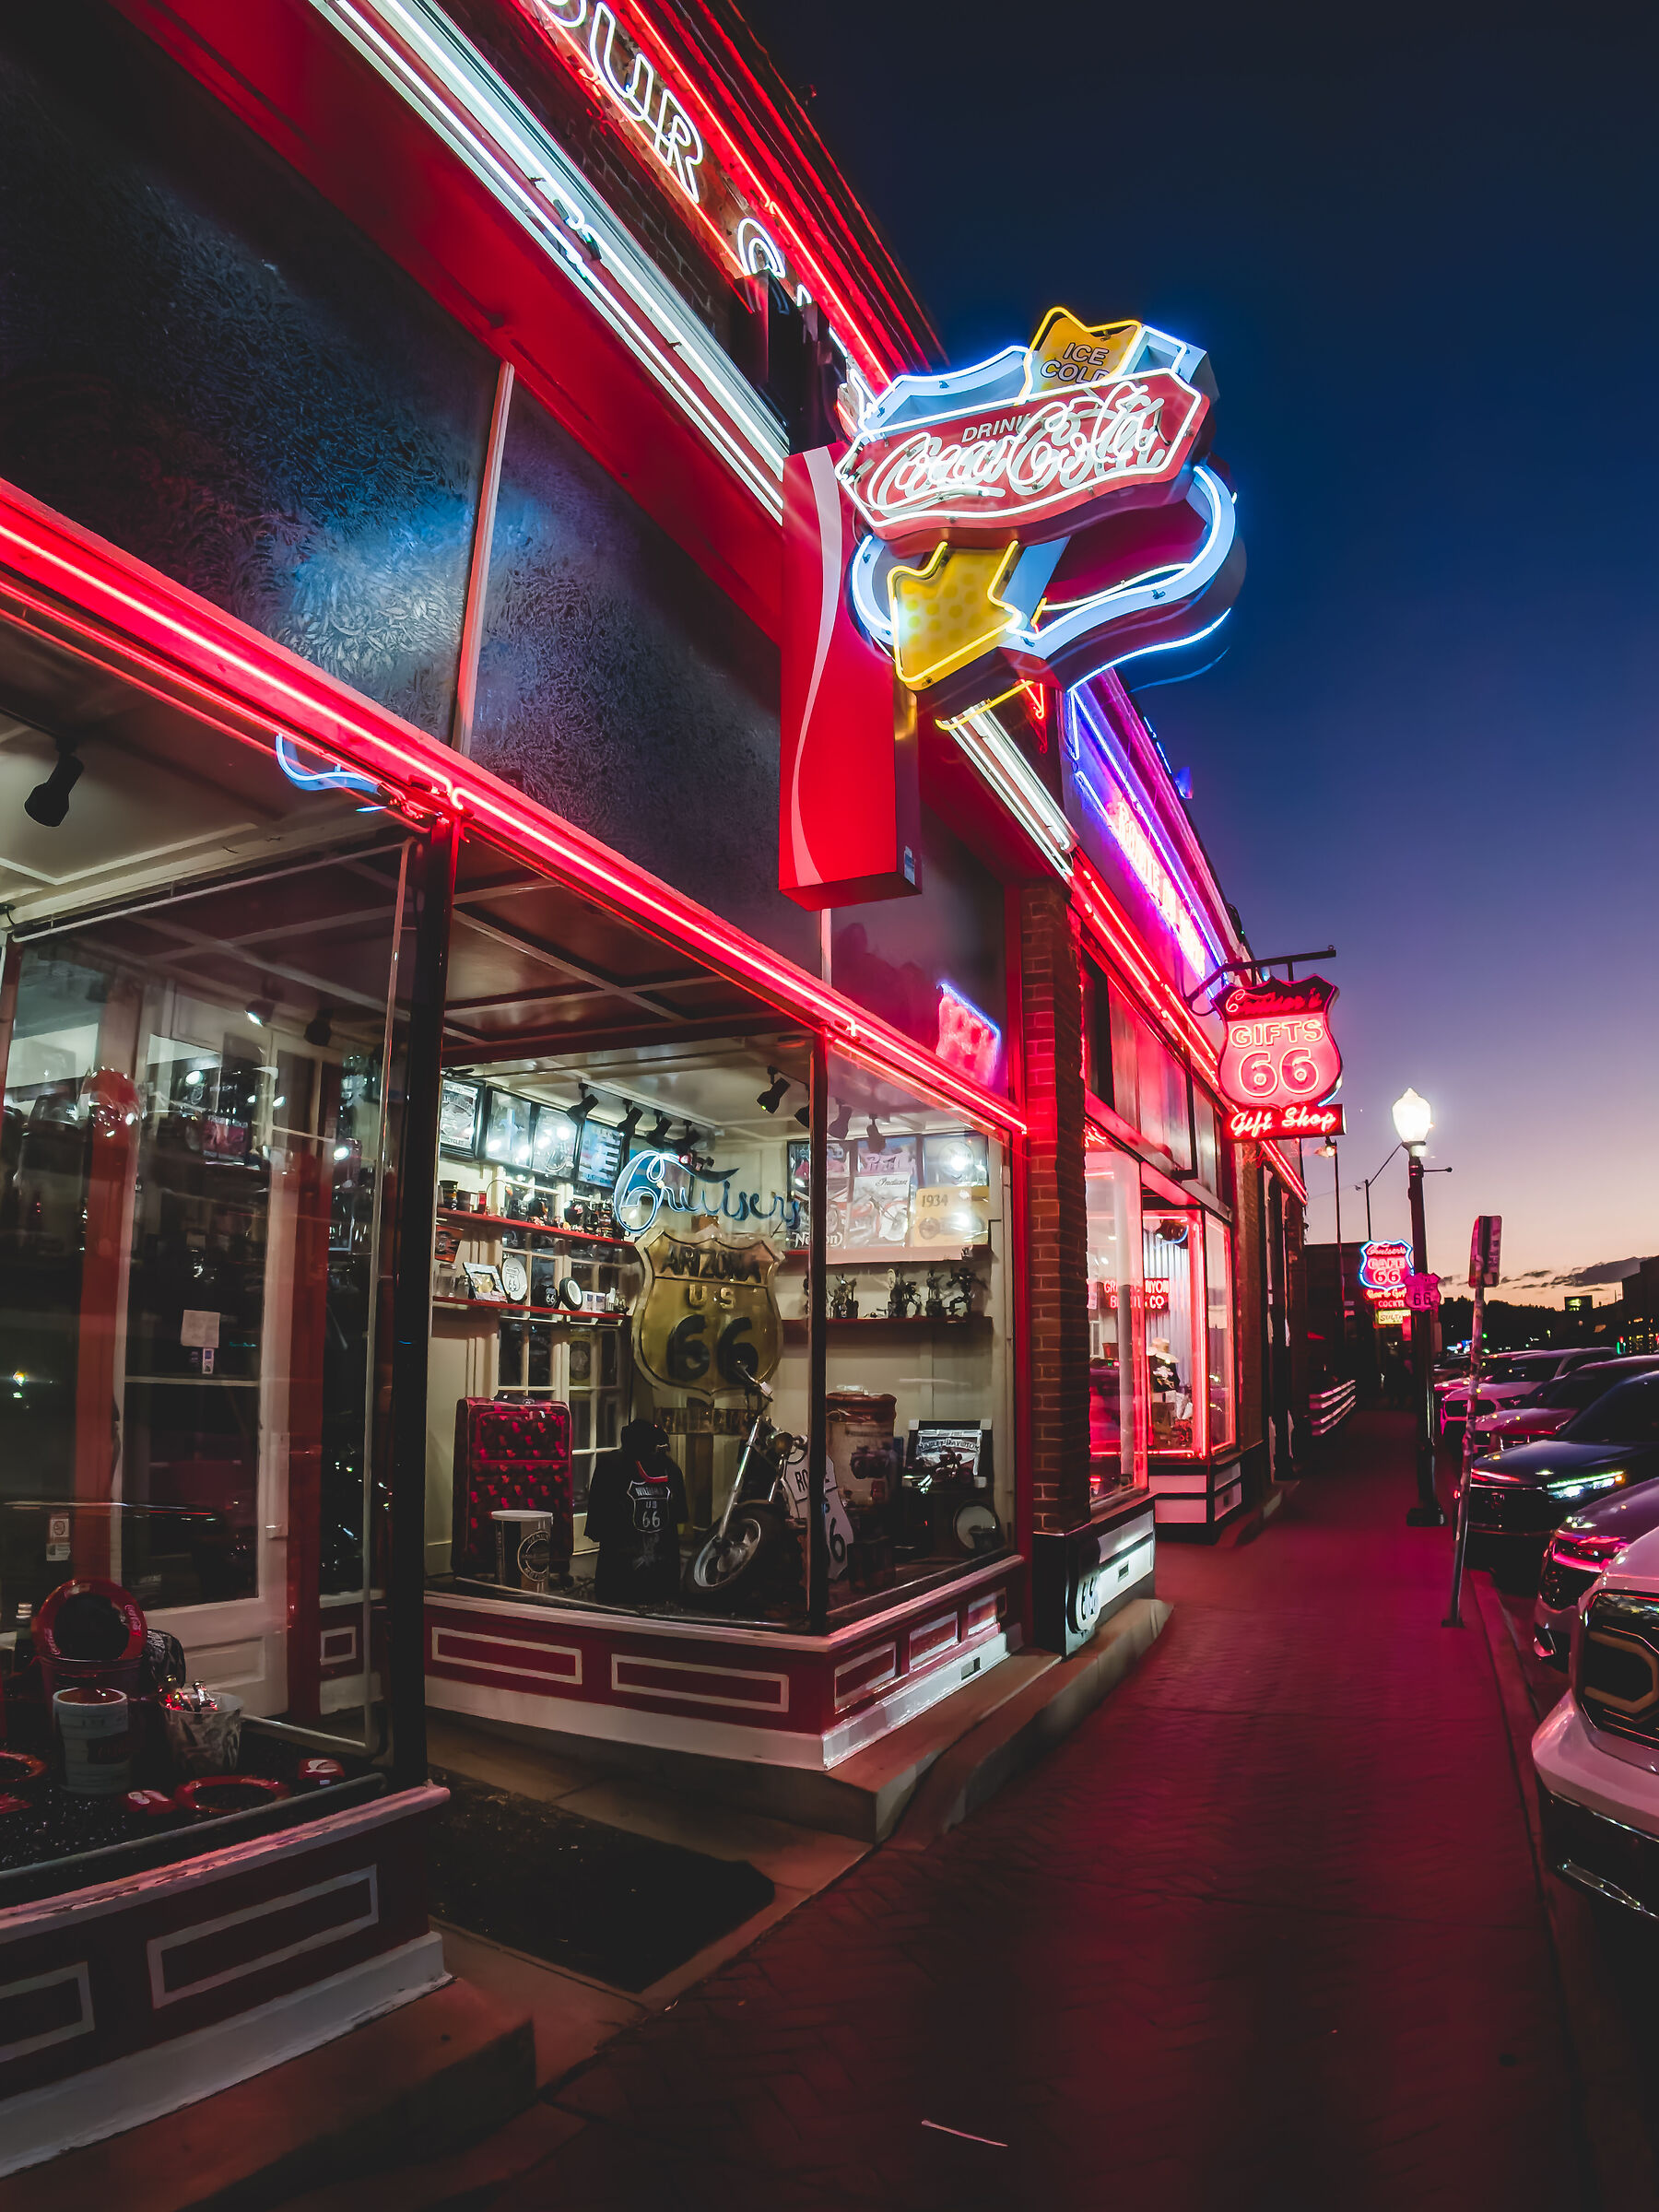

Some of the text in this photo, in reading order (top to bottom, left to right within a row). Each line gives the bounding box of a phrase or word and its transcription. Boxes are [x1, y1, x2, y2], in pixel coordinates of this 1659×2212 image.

[1063, 342, 1109, 366] ICE
[1041, 359, 1110, 383] COLD
[1230, 1019, 1324, 1048] GIFTS
[1238, 1047, 1320, 1097] 66
[1230, 1106, 1335, 1137] Gift Shop
[922, 1194, 948, 1207] 1934
[1143, 1280, 1169, 1293] NYON
[1373, 1269, 1401, 1284] 66
[546, 1293, 555, 1303] 66
[1413, 1292, 1431, 1305] 66
[666, 1313, 759, 1385] 66
[642, 1511, 661, 1528] 66
